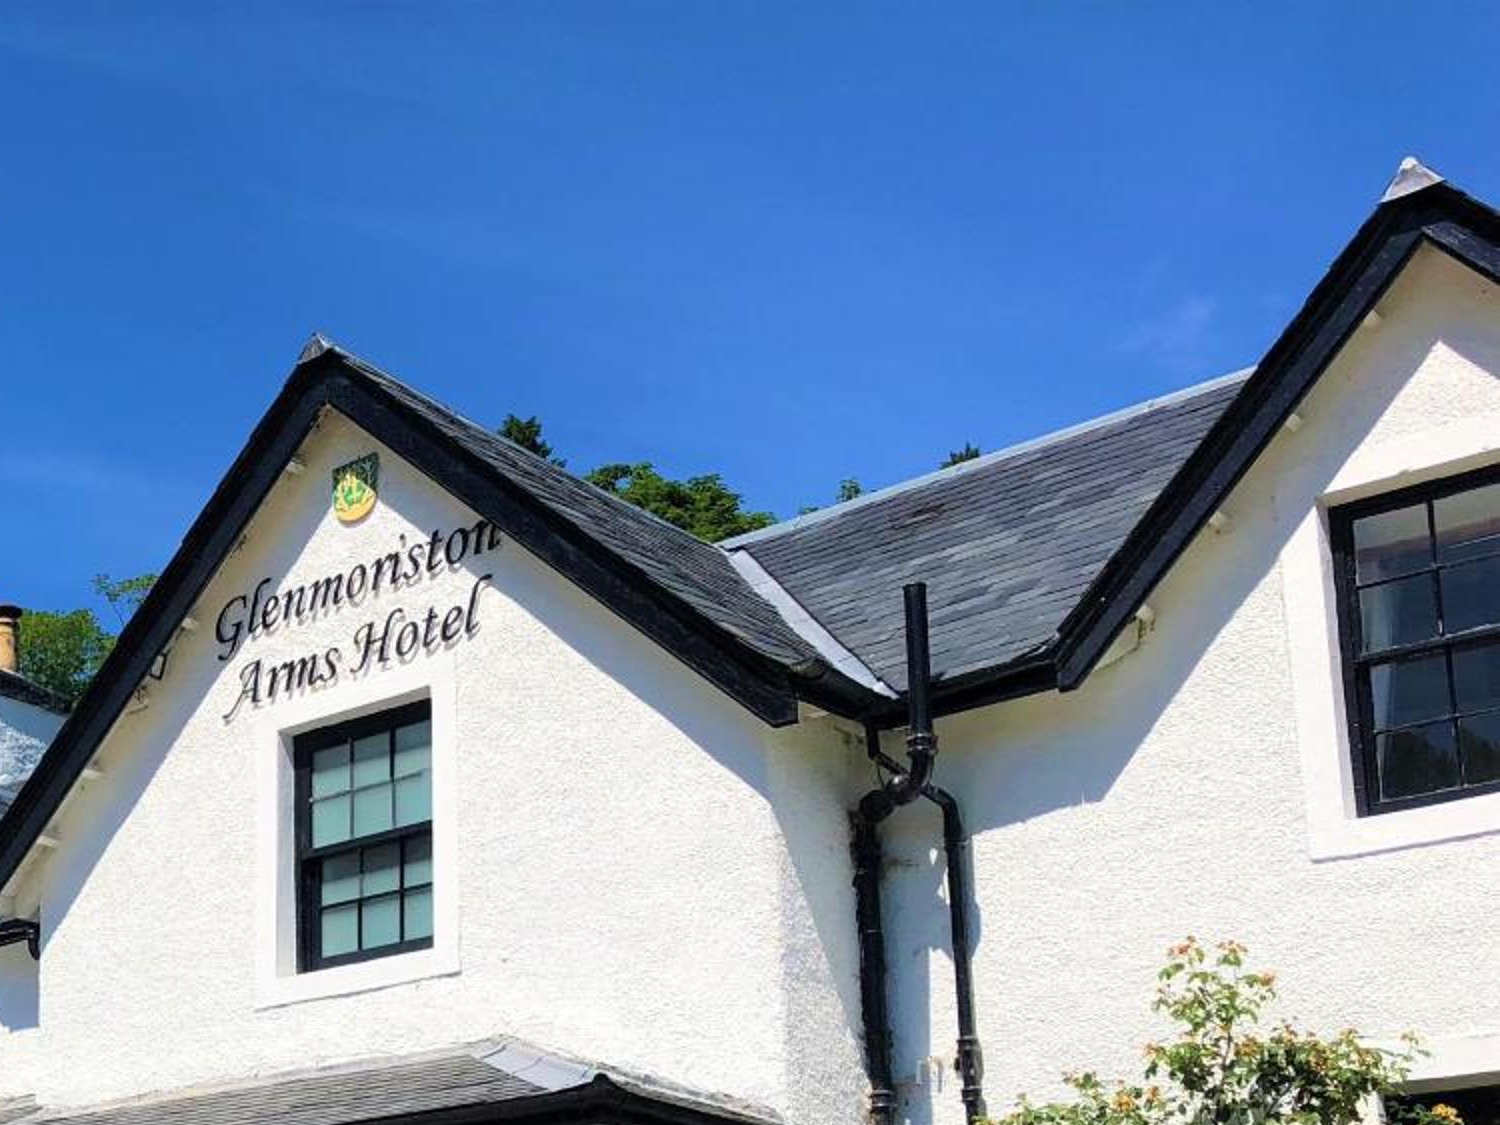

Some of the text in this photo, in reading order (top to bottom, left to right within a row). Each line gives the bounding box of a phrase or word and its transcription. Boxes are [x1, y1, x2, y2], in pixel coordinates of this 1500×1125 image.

[215, 519, 502, 661] Glenmoriston
[223, 574, 492, 720] Arms Hotel
